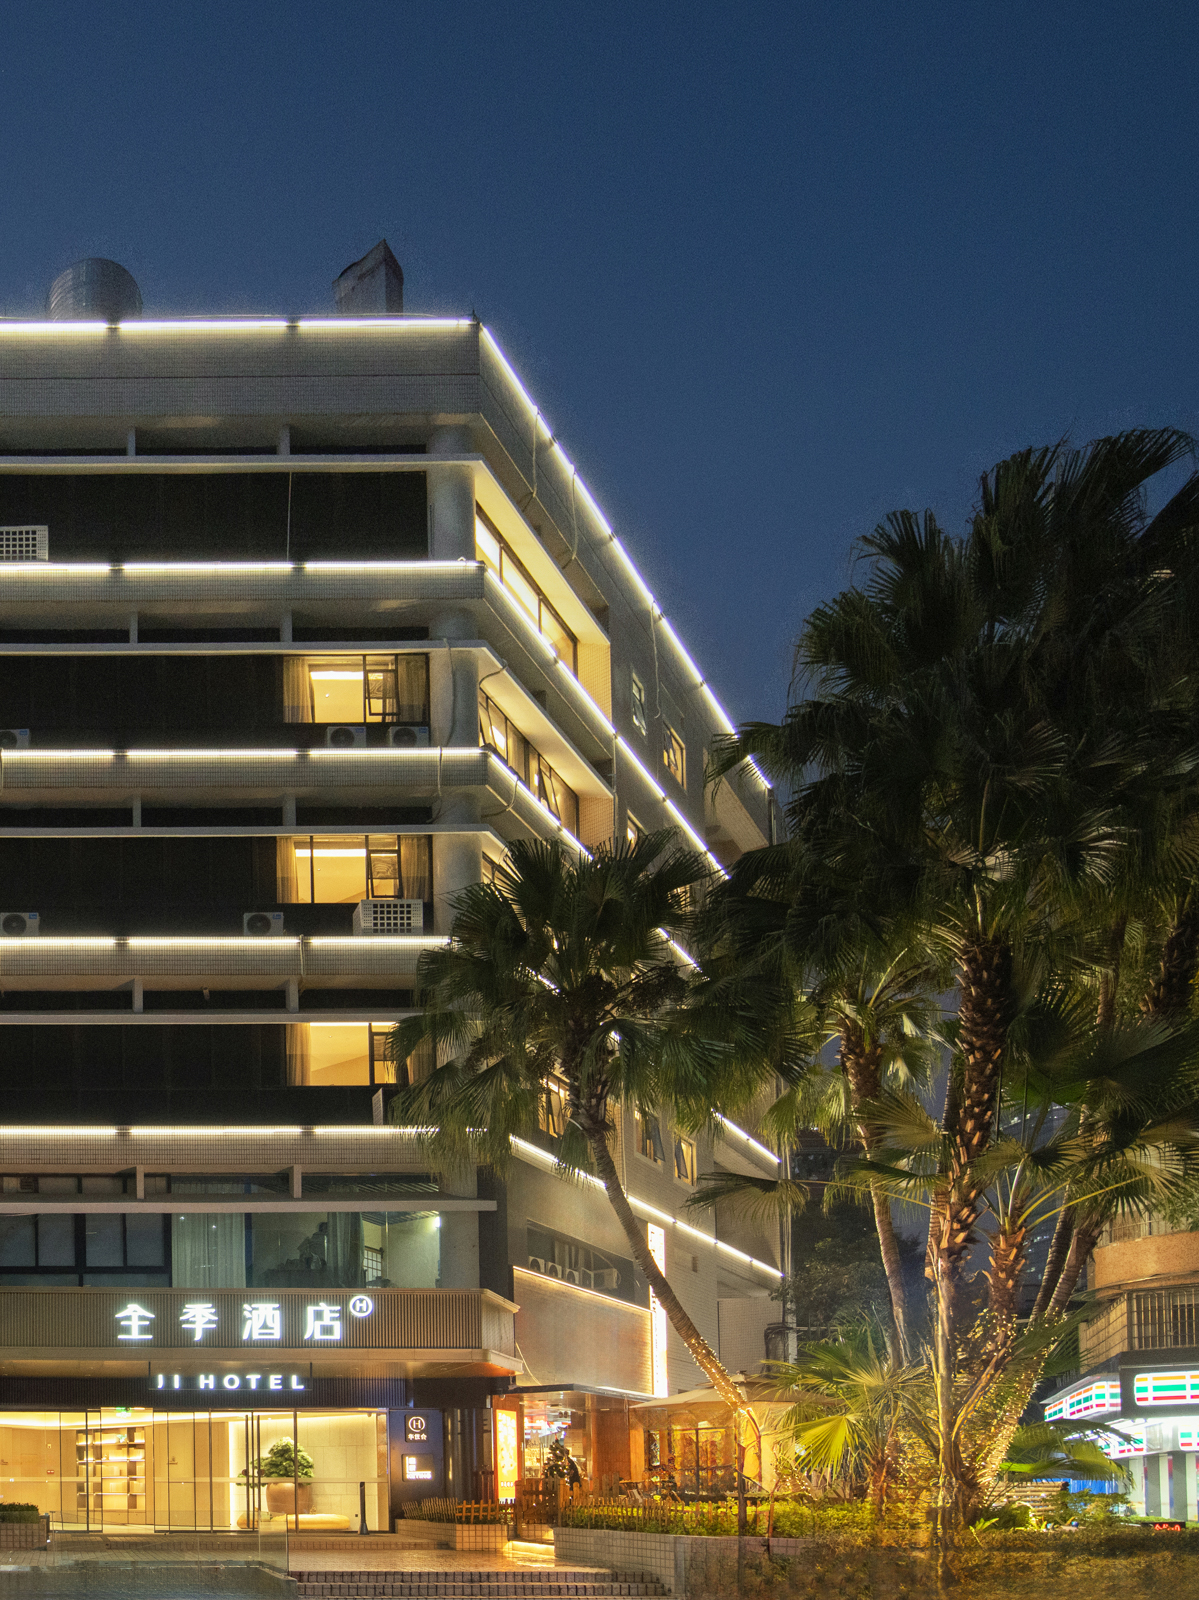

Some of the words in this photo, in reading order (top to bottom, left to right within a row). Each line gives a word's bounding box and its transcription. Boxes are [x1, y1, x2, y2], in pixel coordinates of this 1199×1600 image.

[115, 1302, 341, 1340] 全季酒店
[157, 1374, 180, 1389] JI
[199, 1374, 305, 1390] HOTEL
